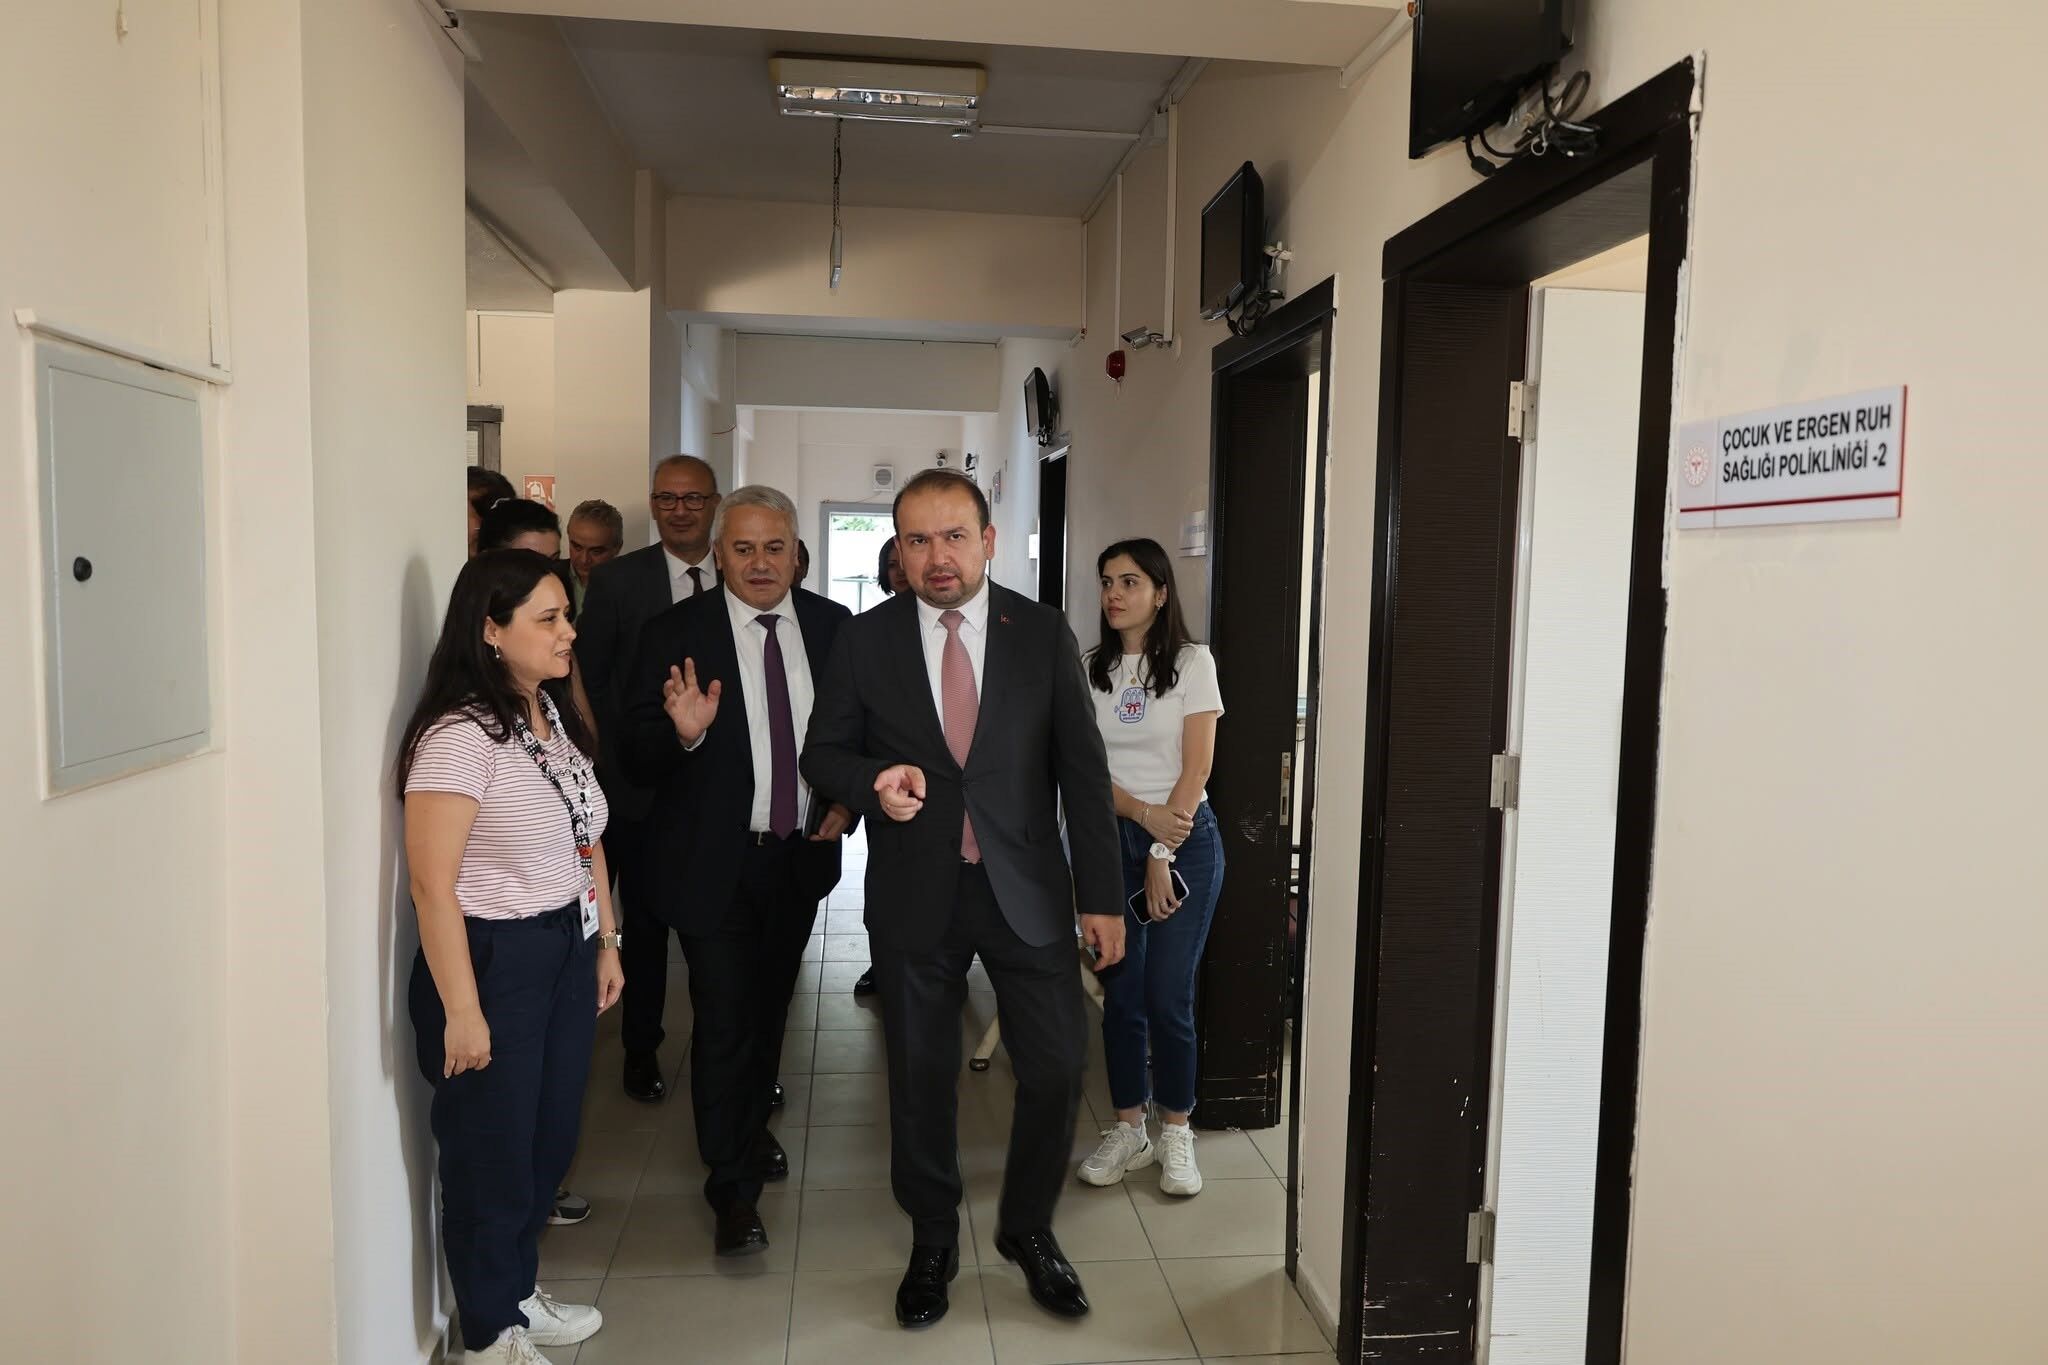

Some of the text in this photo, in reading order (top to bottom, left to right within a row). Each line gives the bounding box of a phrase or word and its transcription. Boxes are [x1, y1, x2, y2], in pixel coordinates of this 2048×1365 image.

[1723, 404, 1891, 455] ÇOCUK VE ERGEN RUH
[1723, 439, 1888, 483] SAĞLIĞI POLİKLİNİĞİ -2
